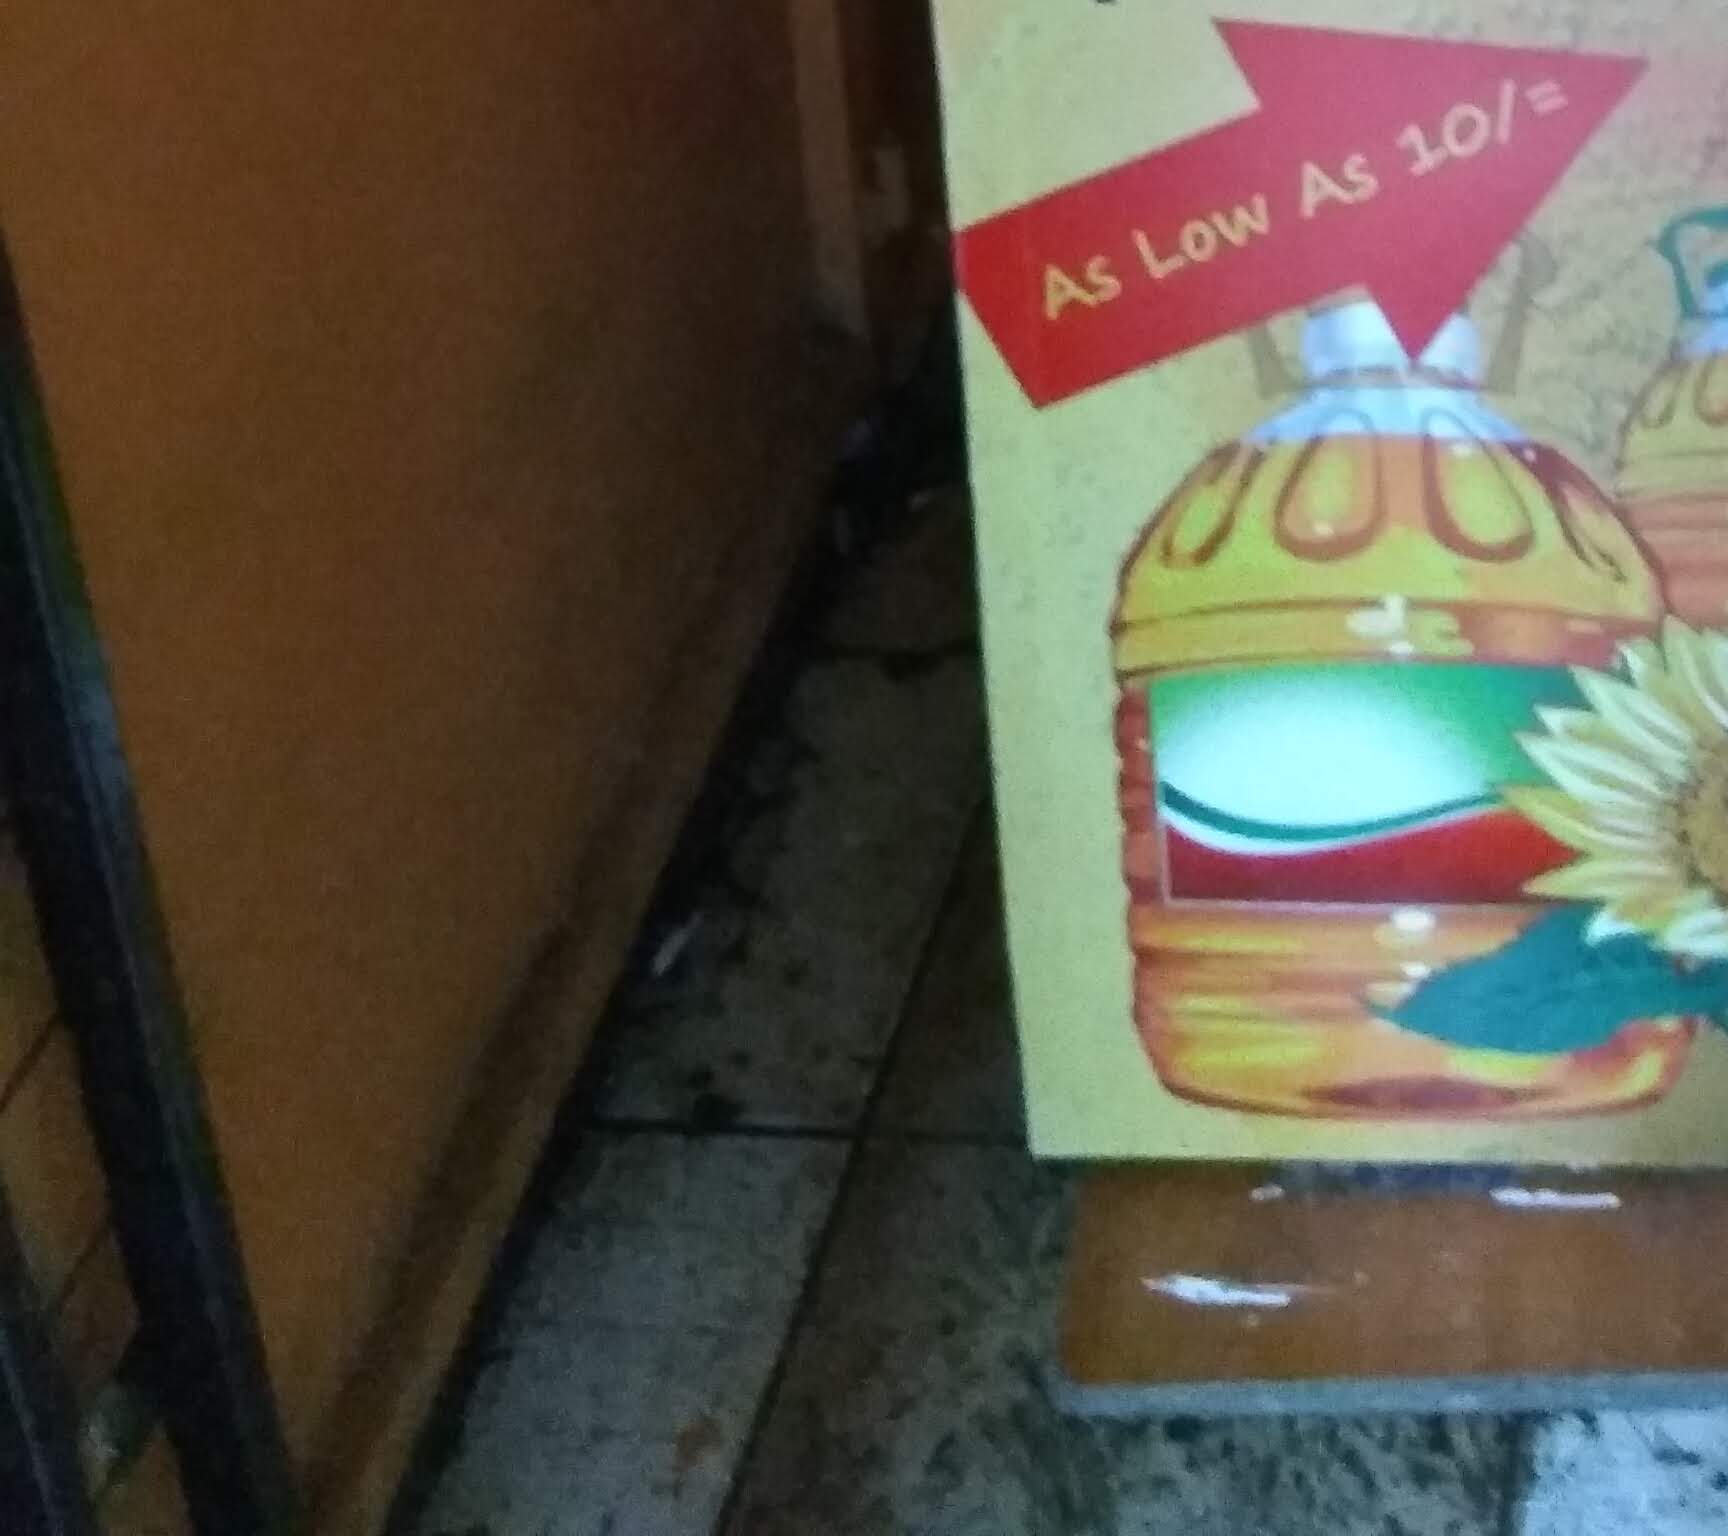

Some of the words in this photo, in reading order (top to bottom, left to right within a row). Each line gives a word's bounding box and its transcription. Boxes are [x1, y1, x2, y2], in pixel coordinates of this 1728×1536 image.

[1041, 256, 1121, 320] As
[1131, 192, 1270, 279] Low
[1300, 152, 1380, 220] As
